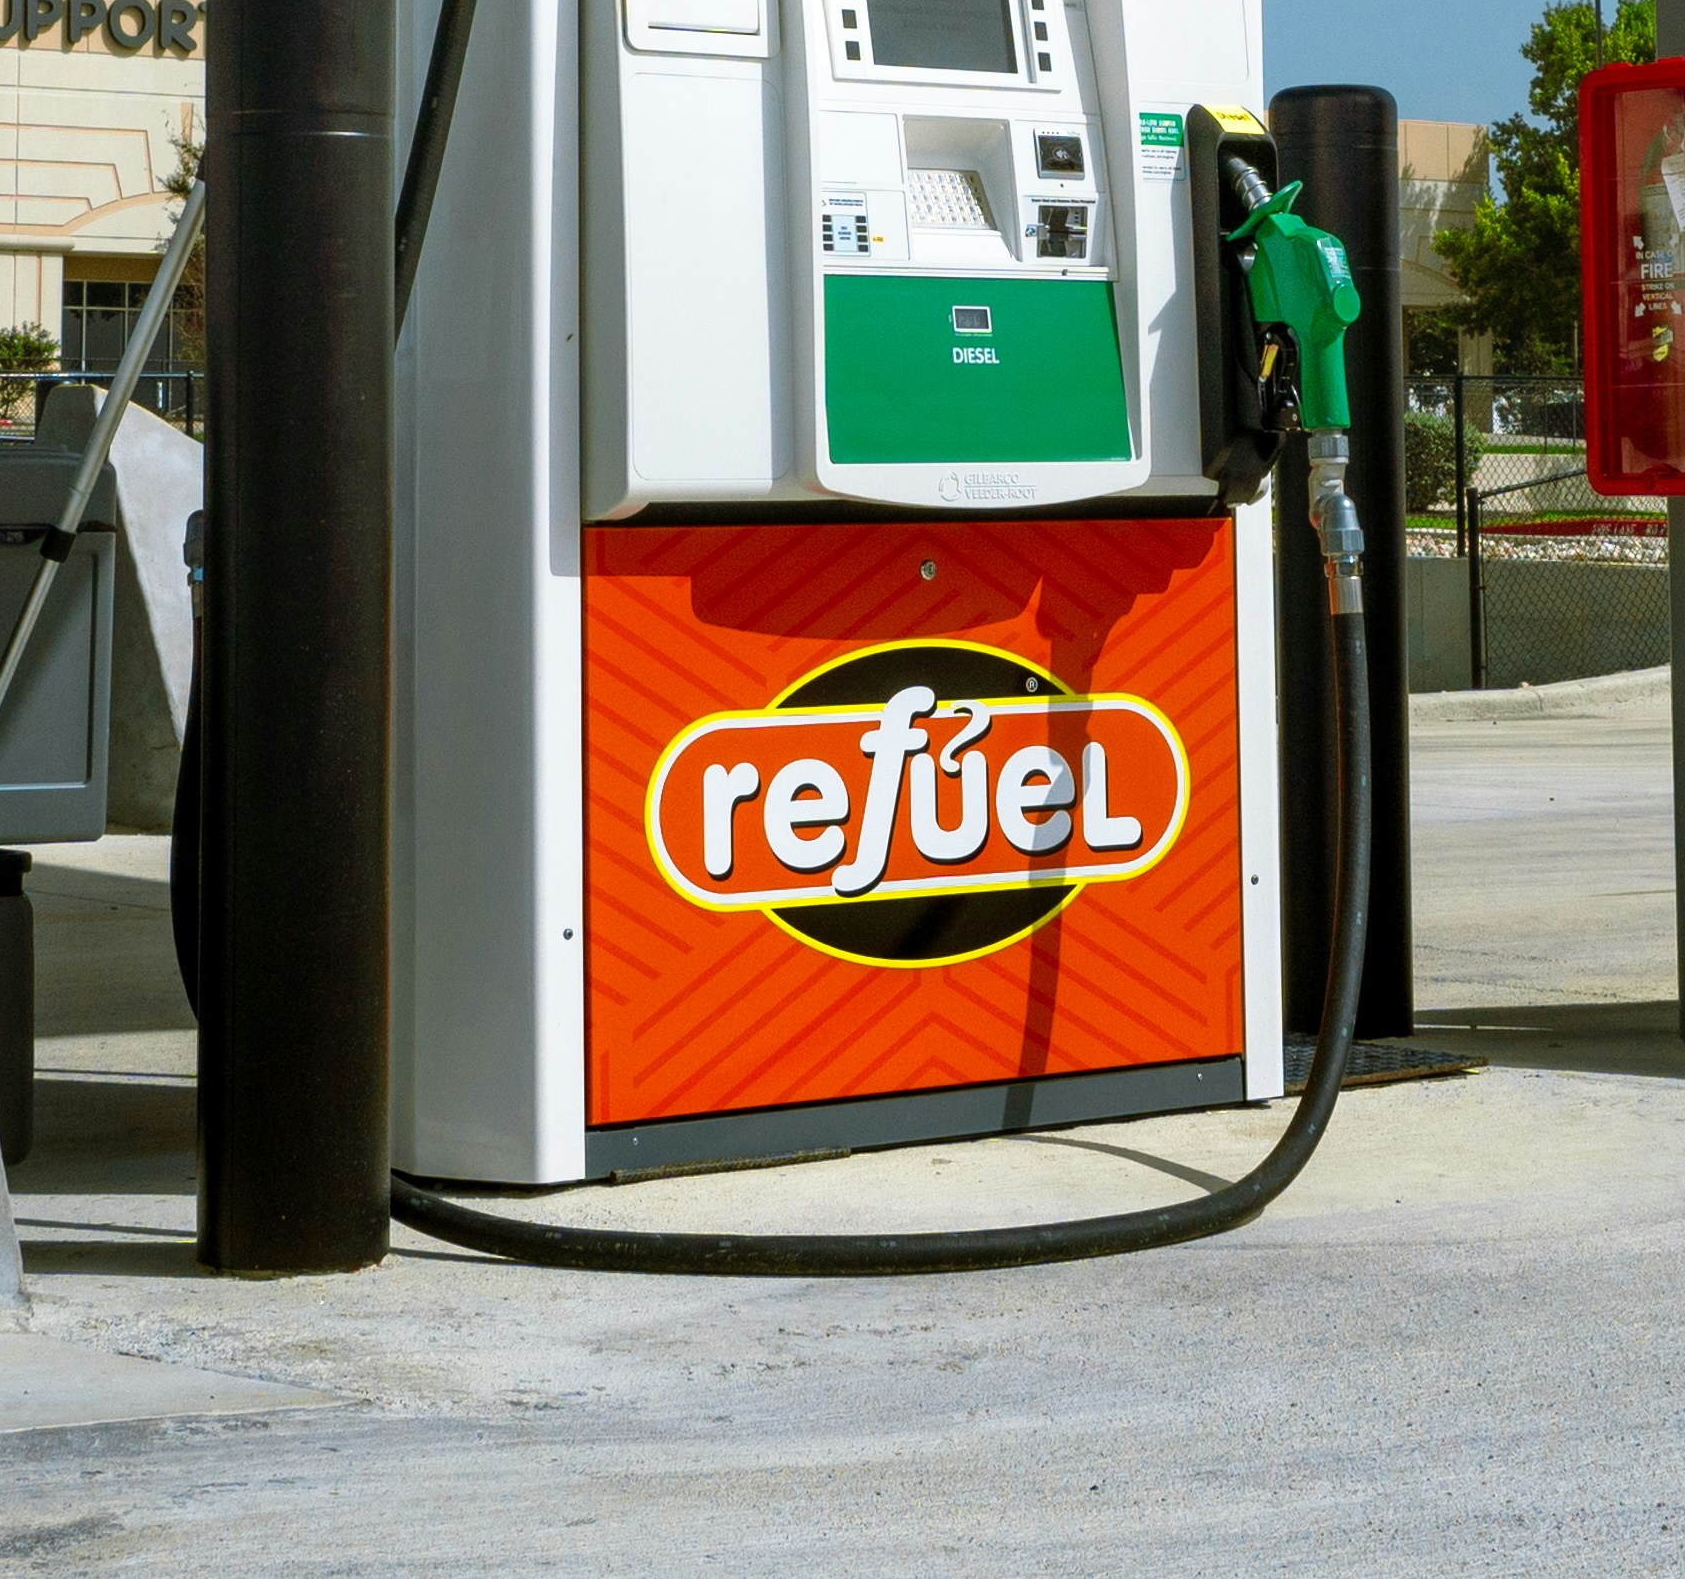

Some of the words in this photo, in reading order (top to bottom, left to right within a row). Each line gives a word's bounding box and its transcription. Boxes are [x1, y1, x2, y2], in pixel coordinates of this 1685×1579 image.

[1635, 251, 1644, 260] IN
[1645, 250, 1665, 260] CASE
[1640, 262, 1673, 279] FIRE
[1641, 283, 1663, 291] STRIKE
[1642, 292, 1674, 301] VERTICAL
[1648, 302, 1667, 310] LINES
[952, 347, 1000, 364] DIESEL
[964, 473, 1019, 485] GILBARCO
[964, 488, 1037, 500] VEEDER-ROOT
